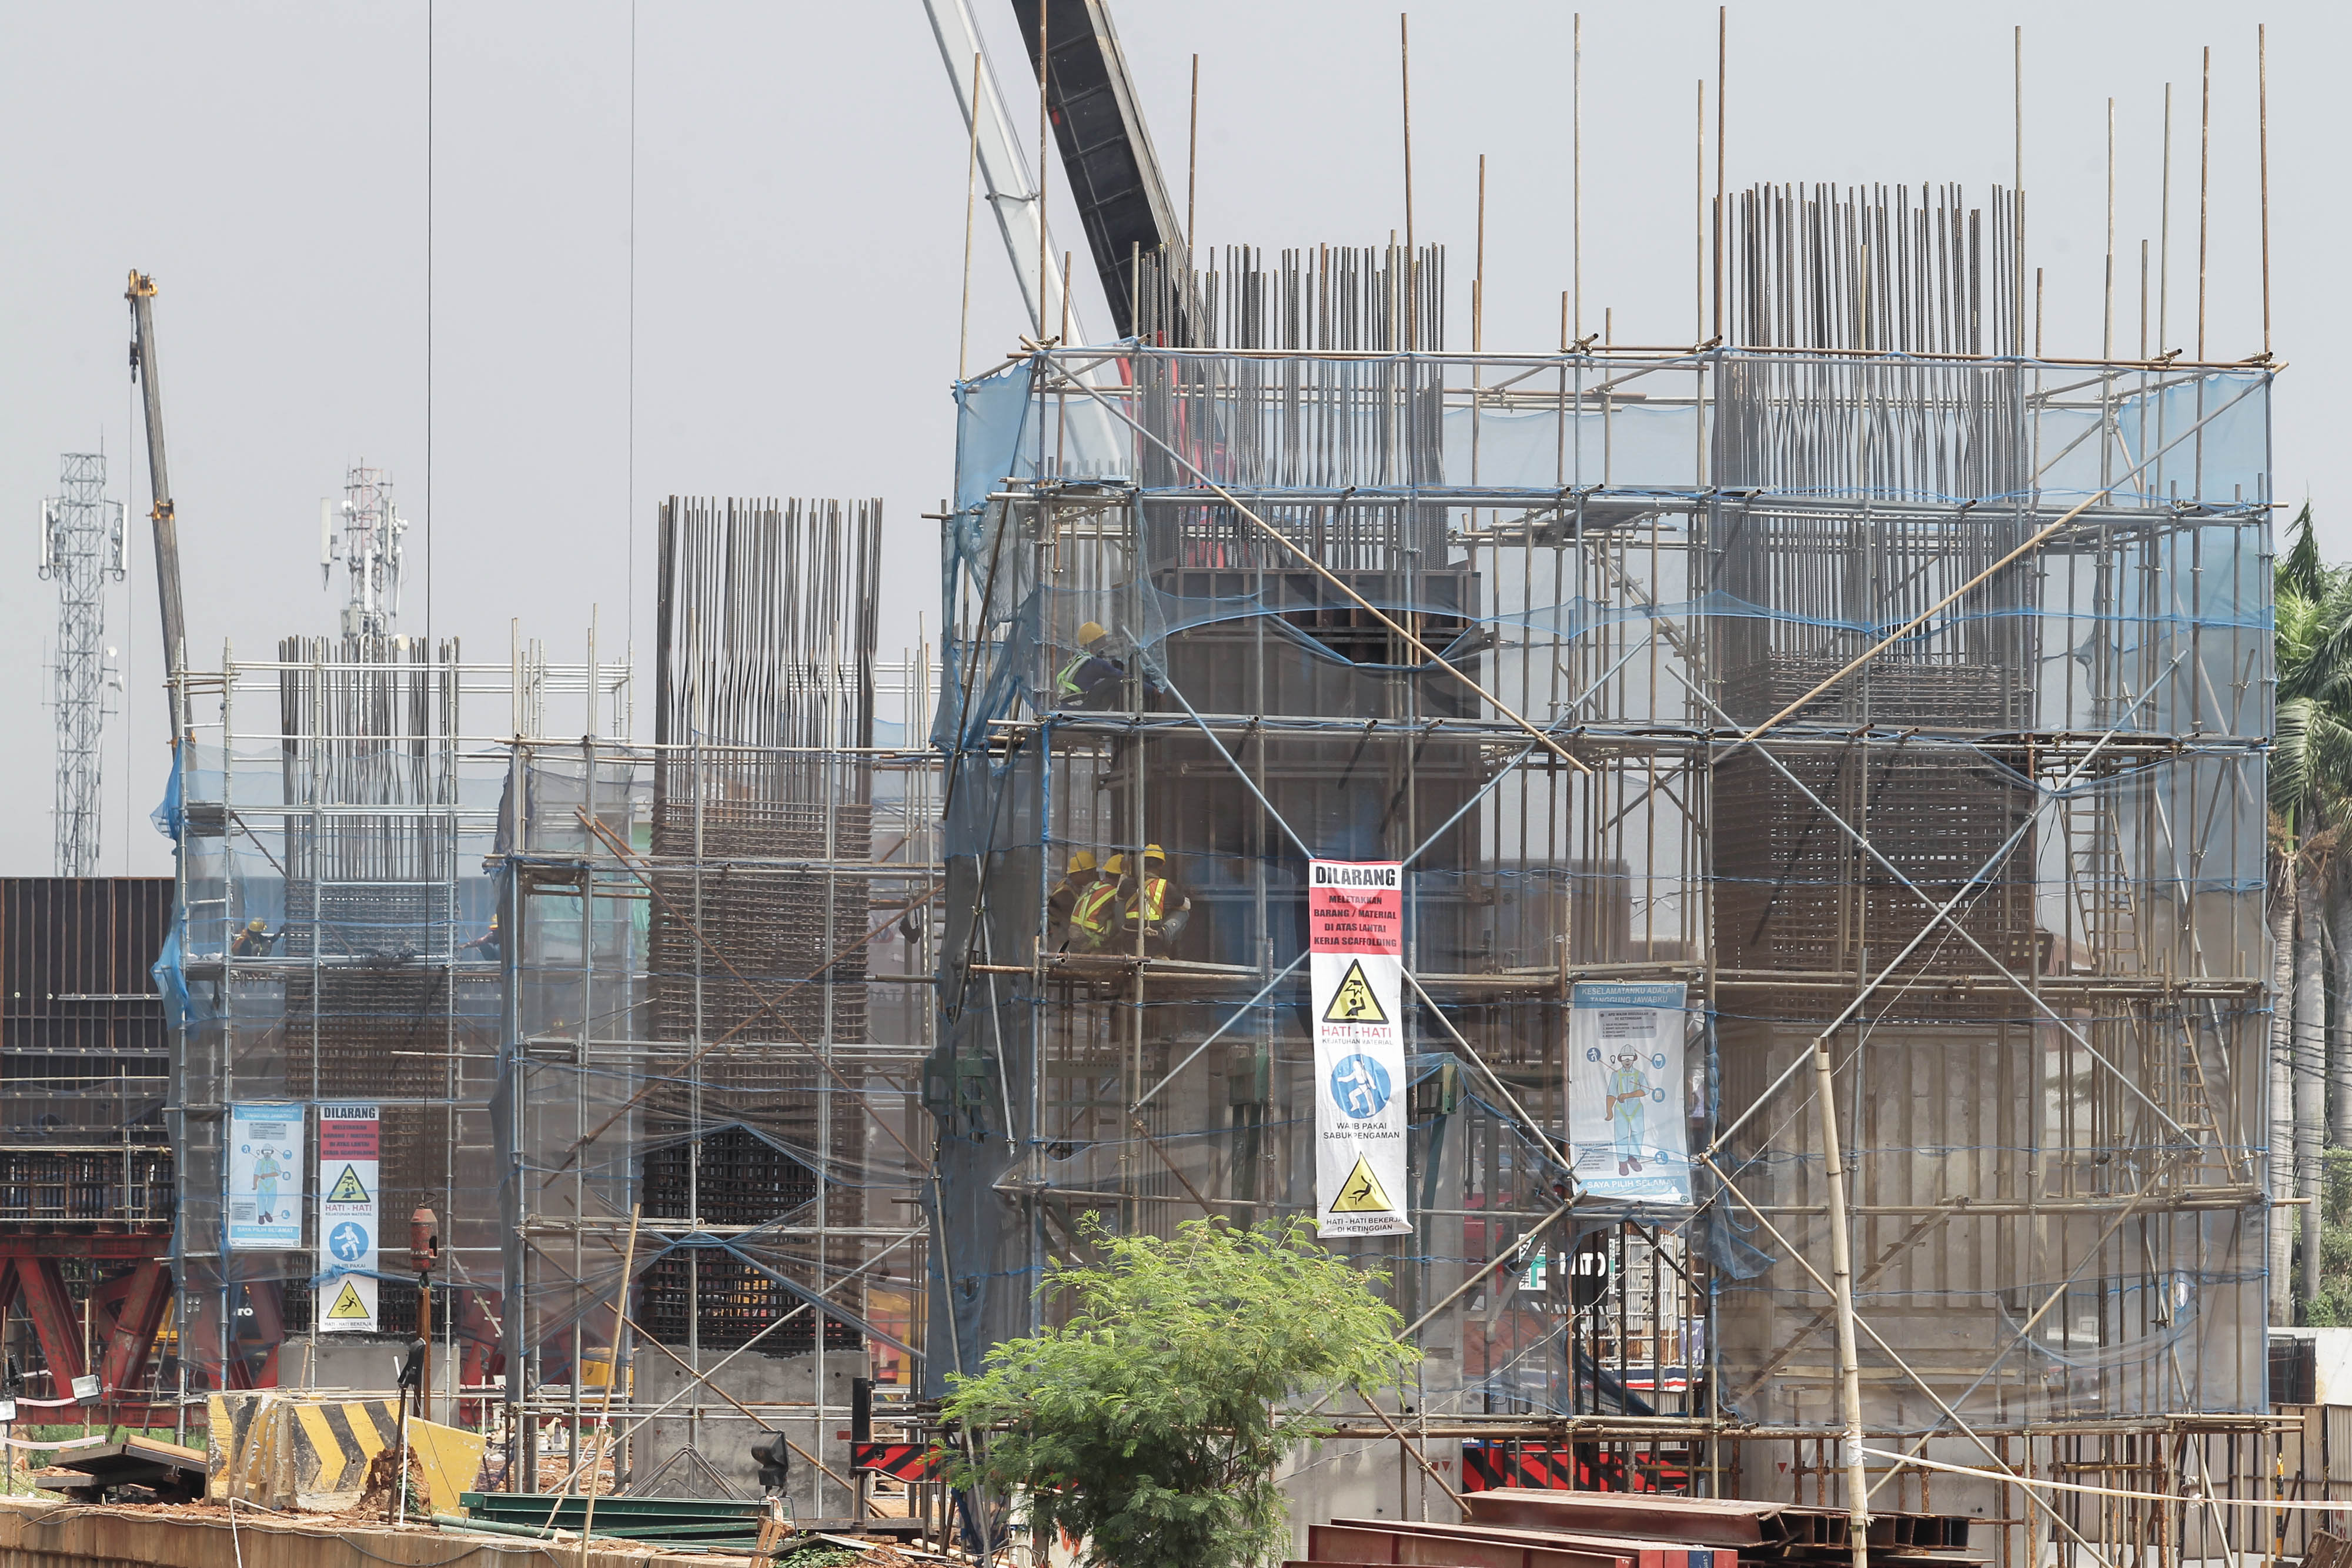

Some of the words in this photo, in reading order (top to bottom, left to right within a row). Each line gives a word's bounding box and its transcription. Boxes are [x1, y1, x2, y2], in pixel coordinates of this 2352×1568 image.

[1315, 866, 1395, 886] DILARANG
[1329, 895, 1382, 905] MELETAKKAN
[1314, 909, 1350, 917] BARANG
[1358, 910, 1396, 920] MATERIAL
[1324, 923, 1334, 931] DI
[1335, 923, 1357, 931] ATAS
[1359, 924, 1386, 932] LANTAI
[1342, 937, 1397, 947] SCAFFOLDING
[1321, 1026, 1351, 1037] HATI
[1362, 1027, 1392, 1038] HATI
[324, 1107, 375, 1119] DILARANG
[1587, 1180, 1610, 1188] SAYA
[1347, 1224, 1393, 1232] KETINGGIAN
